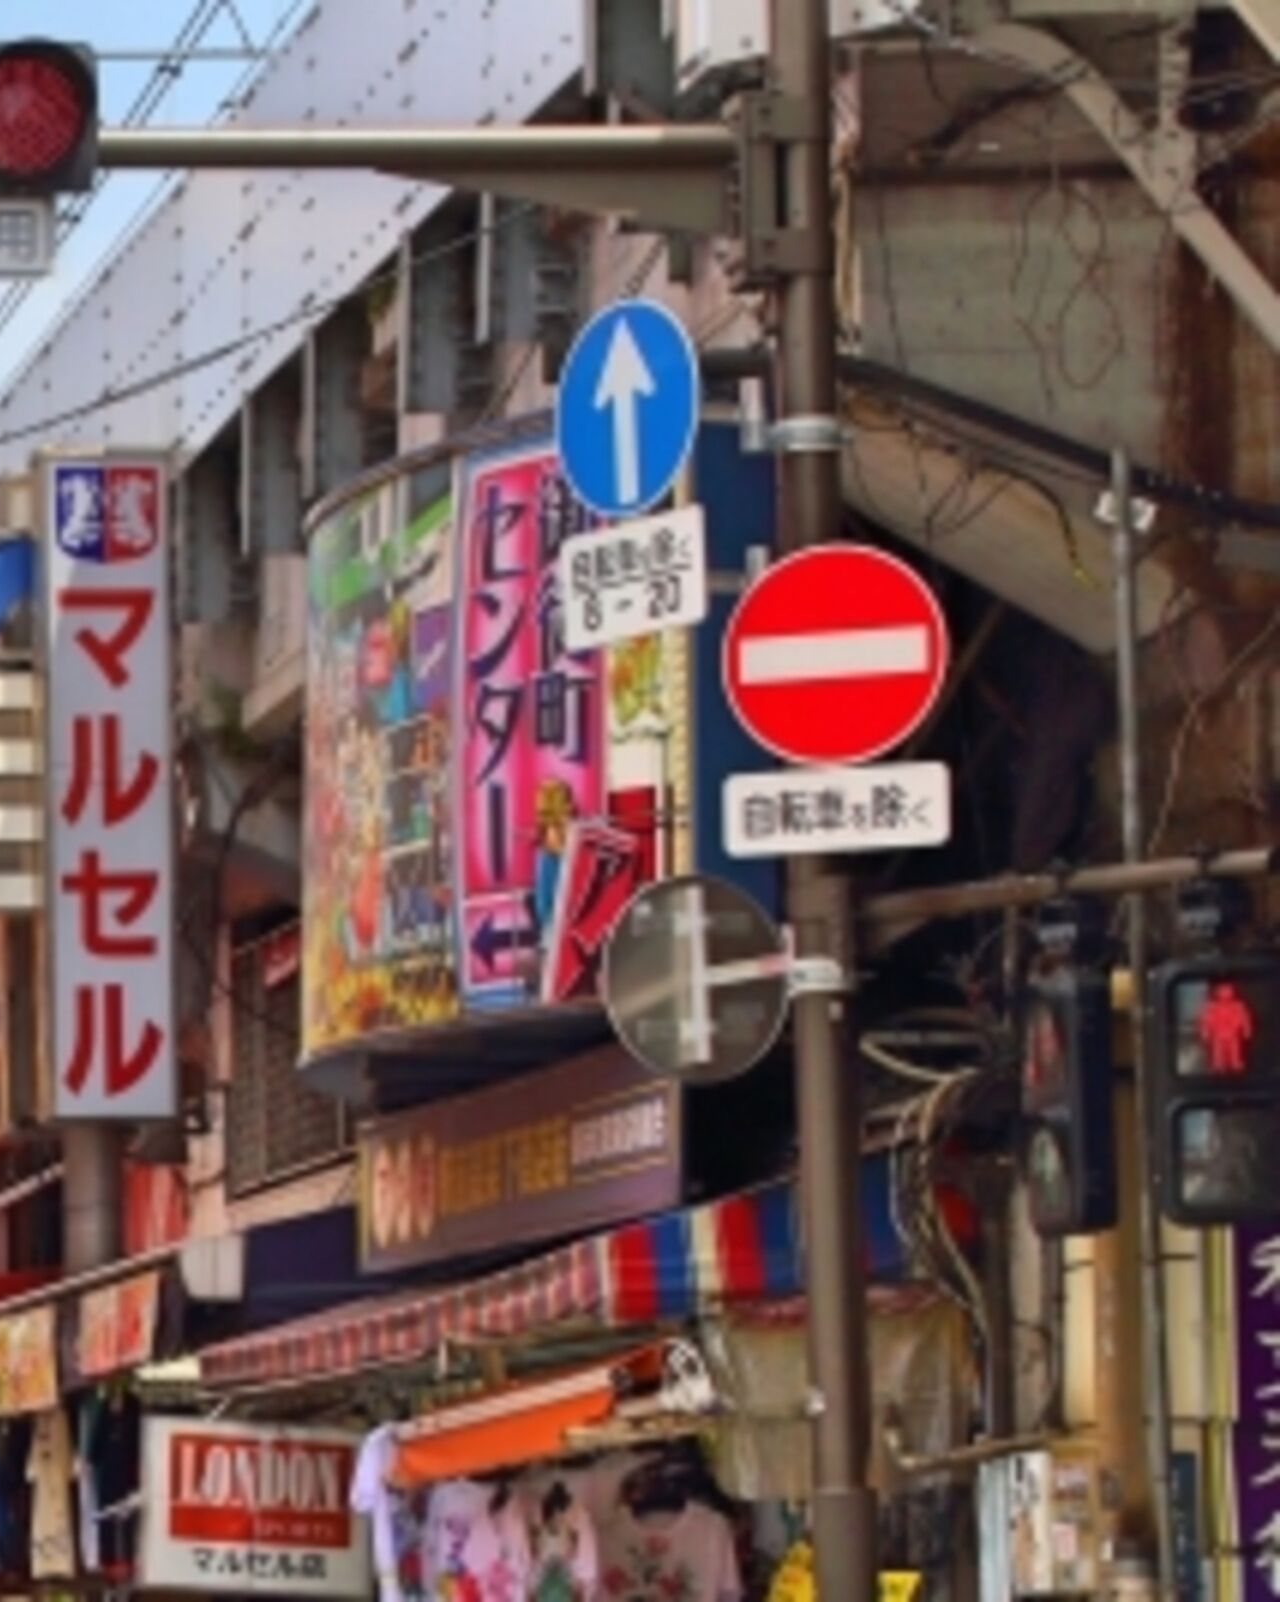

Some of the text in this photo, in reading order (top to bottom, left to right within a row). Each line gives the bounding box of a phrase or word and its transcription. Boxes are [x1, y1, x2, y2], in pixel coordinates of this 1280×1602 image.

[470, 485, 530, 885] センター
[55, 588, 165, 1098] マルセル
[743, 780, 933, 842] 自転車を除く
[179, 1442, 340, 1514] LONDON
